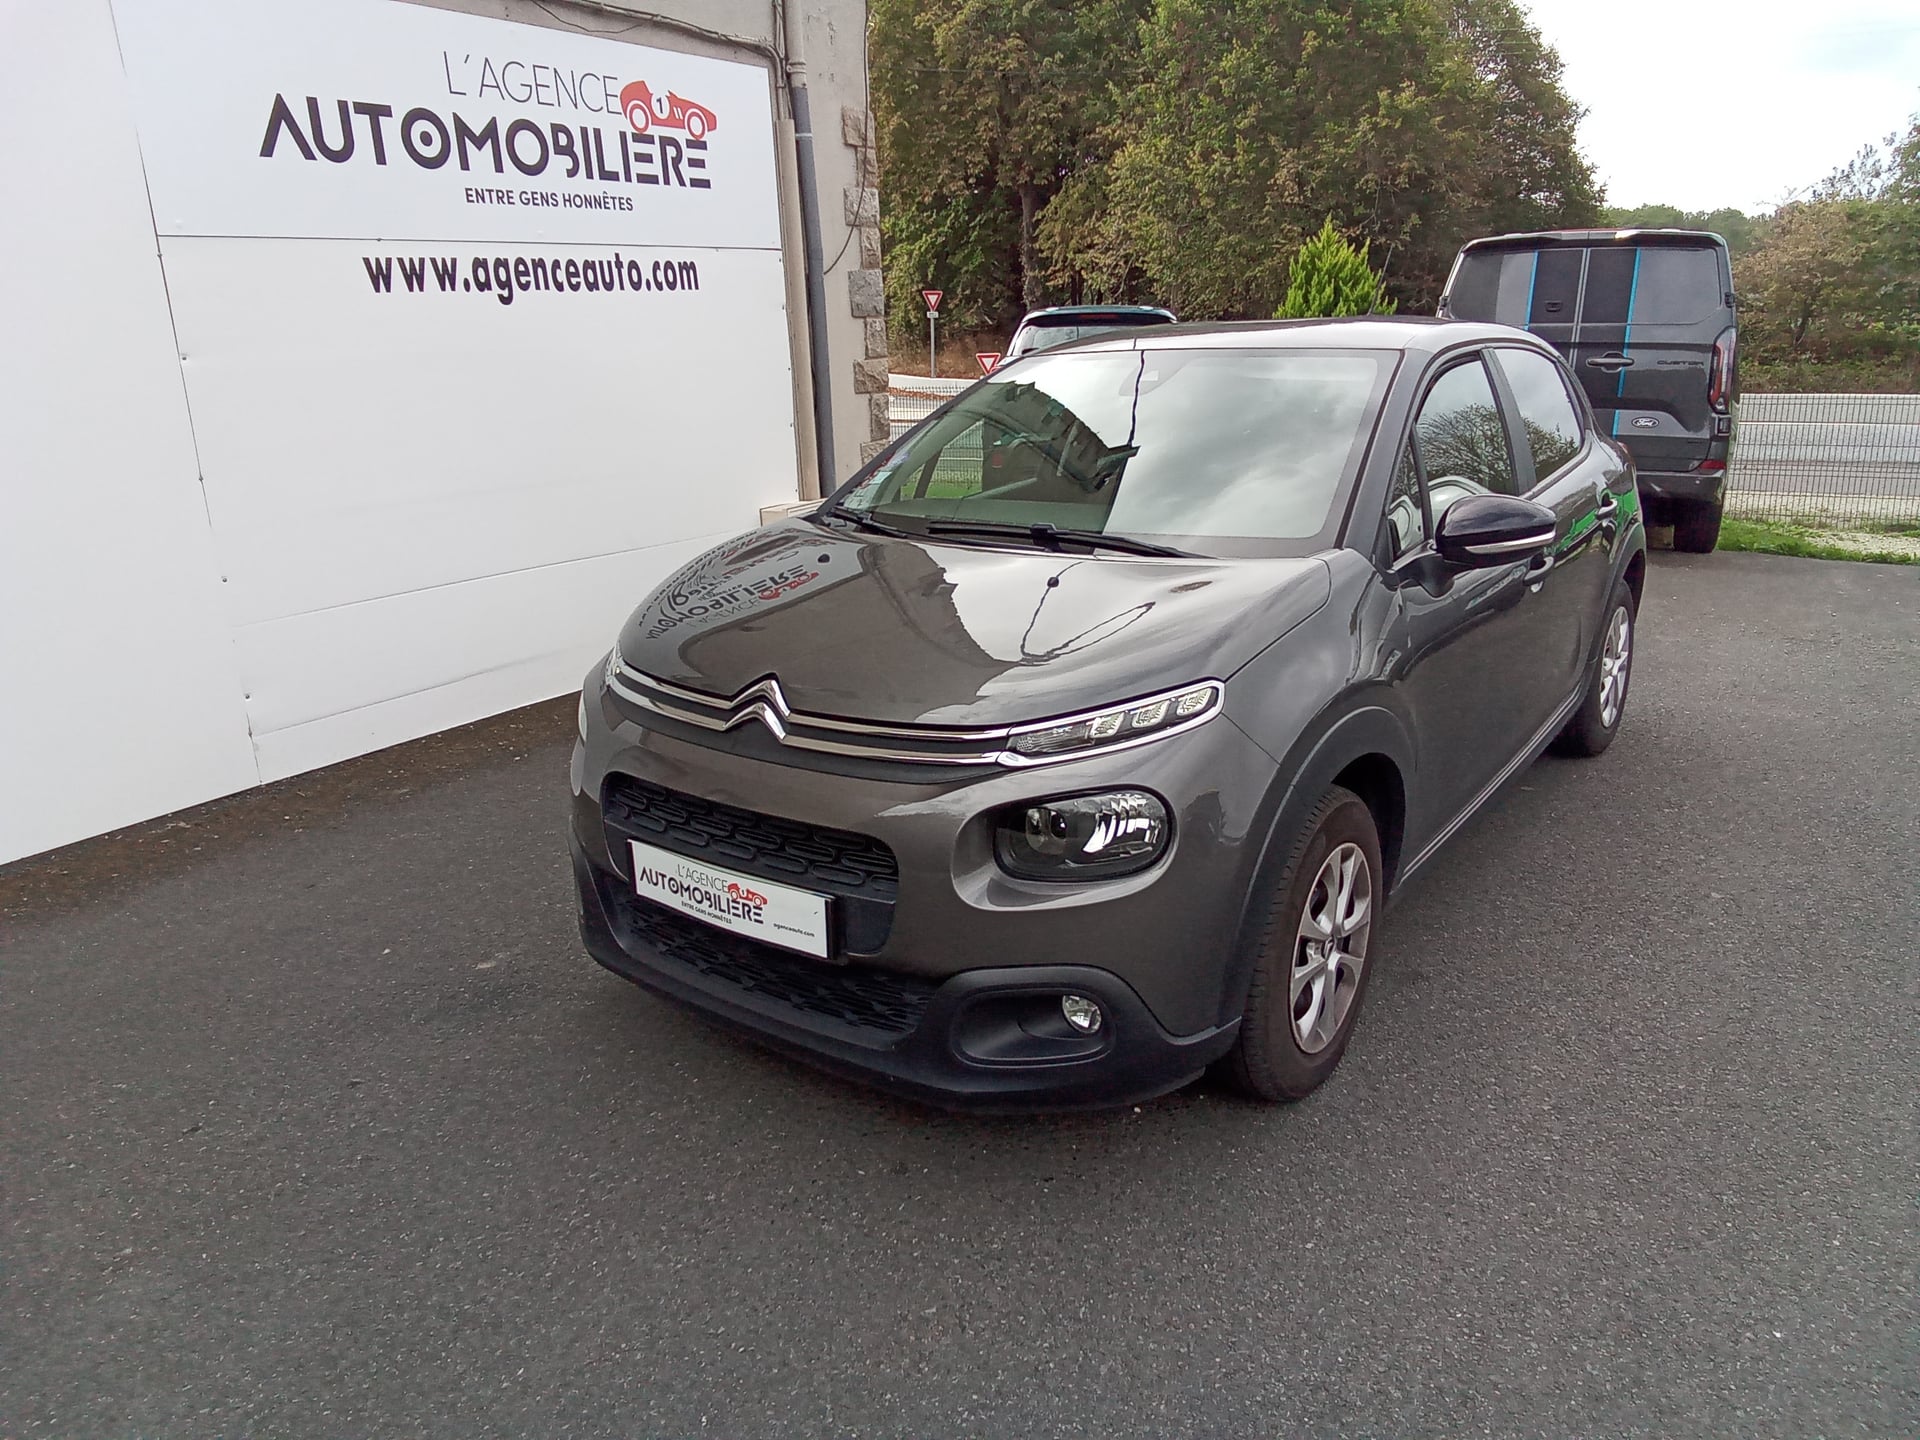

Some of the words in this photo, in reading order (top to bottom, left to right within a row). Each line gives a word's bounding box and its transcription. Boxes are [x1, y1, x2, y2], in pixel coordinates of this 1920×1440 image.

[443, 50, 621, 115] L'AGENCE
[465, 188, 515, 206] ENTRE
[519, 190, 559, 207] GENS
[562, 190, 633, 211] HONNÊTES
[363, 252, 699, 305] www.agenceauto.com
[676, 864, 728, 893] L'AGENCE
[773, 922, 815, 938] agenceauto.com
